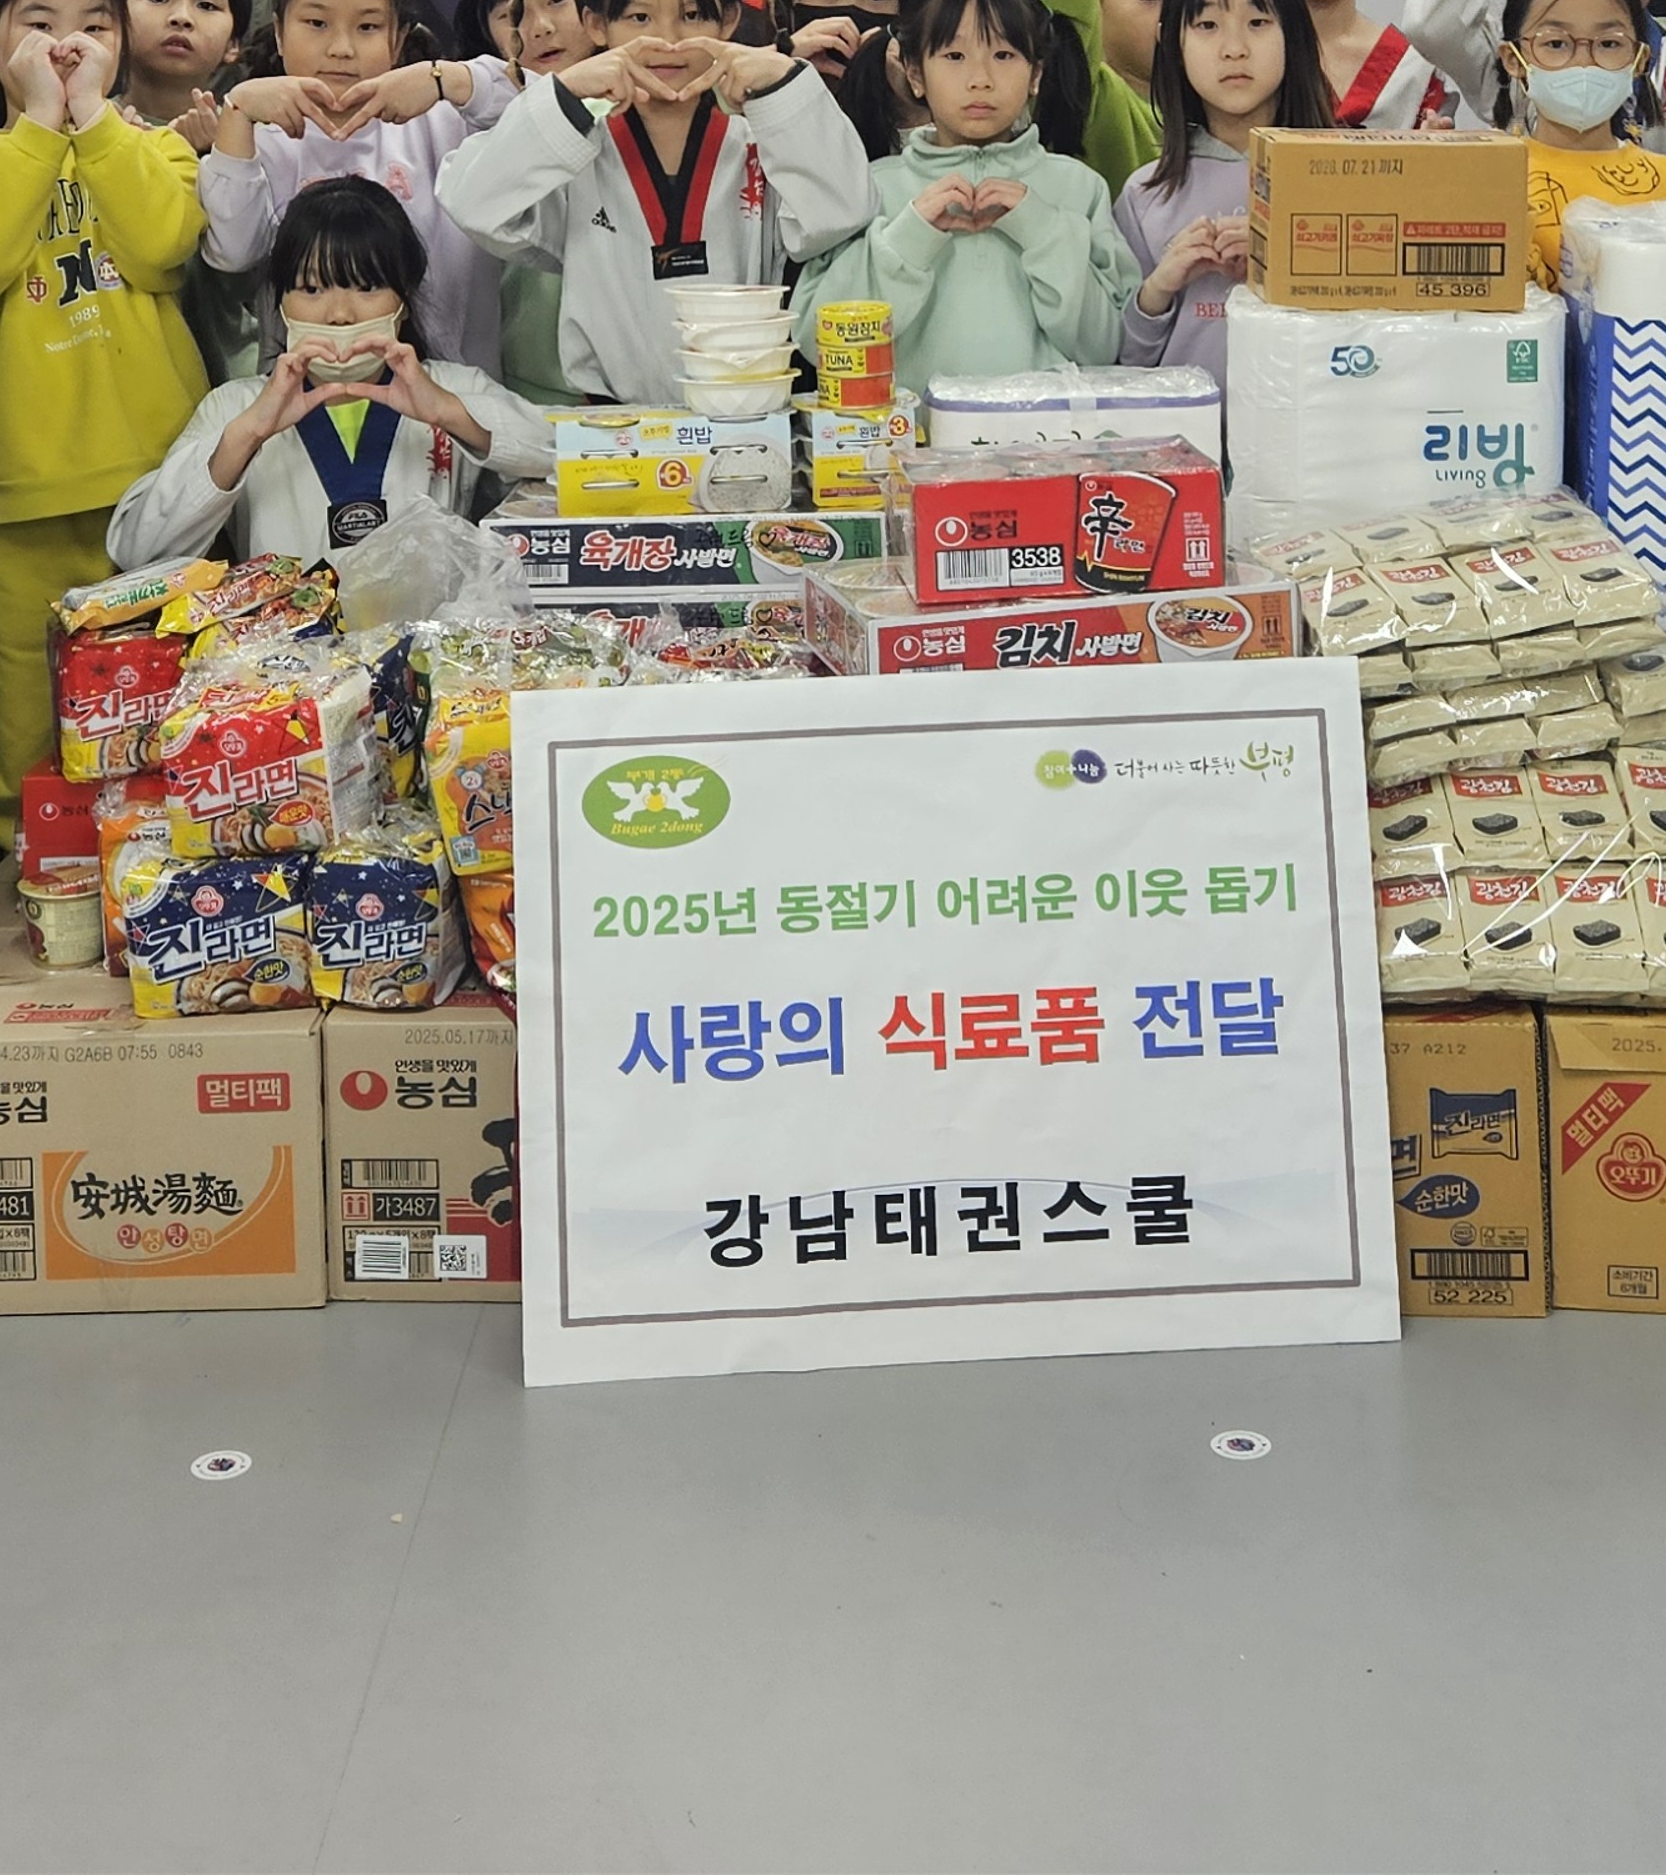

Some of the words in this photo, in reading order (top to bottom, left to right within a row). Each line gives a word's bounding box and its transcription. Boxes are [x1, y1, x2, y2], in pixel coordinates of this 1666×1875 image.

[1419, 285, 1444, 297] 45
[1450, 285, 1487, 297] 396
[69, 304, 101, 328] 1989
[825, 354, 853, 366] TUNA
[676, 426, 712, 445] 흰밥
[1423, 423, 1536, 488] 리빙
[970, 520, 1017, 541] 농심
[1082, 491, 1134, 561] 辛
[530, 535, 571, 555] 농심
[581, 529, 677, 572] 육개장
[674, 547, 737, 569] 사발면
[1011, 546, 1062, 568] 3538
[922, 634, 966, 655] 농심
[993, 620, 1077, 669] 김치
[1076, 632, 1144, 660] 사발면
[1114, 758, 1158, 778] 더불어
[1162, 760, 1184, 775] 사는
[1189, 756, 1235, 775] 따뜻한
[1239, 741, 1294, 781] 부평
[183, 756, 299, 823] 진라면
[1461, 776, 1513, 796] 광천김
[1546, 776, 1598, 796] 광천김
[660, 820, 703, 834] 2dong
[593, 885, 757, 938] 2025년
[777, 877, 917, 934] 동절기
[936, 871, 1078, 926] 어려운
[1096, 866, 1189, 921] 이웃
[1205, 862, 1299, 916] 돕기
[147, 914, 276, 985] 진라면
[316, 921, 427, 971] 진라면
[405, 1028, 514, 1046] 2025.05.17까지
[618, 998, 845, 1085] 사랑의
[878, 986, 1105, 1073] 식료품
[1133, 976, 1284, 1060] 전달
[118, 1044, 157, 1061] 07:55
[168, 1042, 204, 1059] 0843
[1423, 1043, 1467, 1055] A212
[395, 1059, 433, 1074] 인생을
[436, 1059, 477, 1074] 맛있게
[13, 1080, 48, 1094] 맛있게
[205, 1077, 282, 1109] 멀티팩
[395, 1075, 478, 1110] 농심
[1445, 1110, 1502, 1137] 진라면
[1565, 1087, 1626, 1148] 멀티팩
[1609, 1165, 1657, 1186] 오뚜기
[375, 1197, 437, 1218] 가3487
[1414, 1182, 1470, 1212] 순한맛
[703, 1173, 1194, 1268] 강남태권스쿨
[119, 1226, 209, 1252] 안성탕면
[1434, 1291, 1460, 1304] 52
[1469, 1291, 1508, 1304] 225
